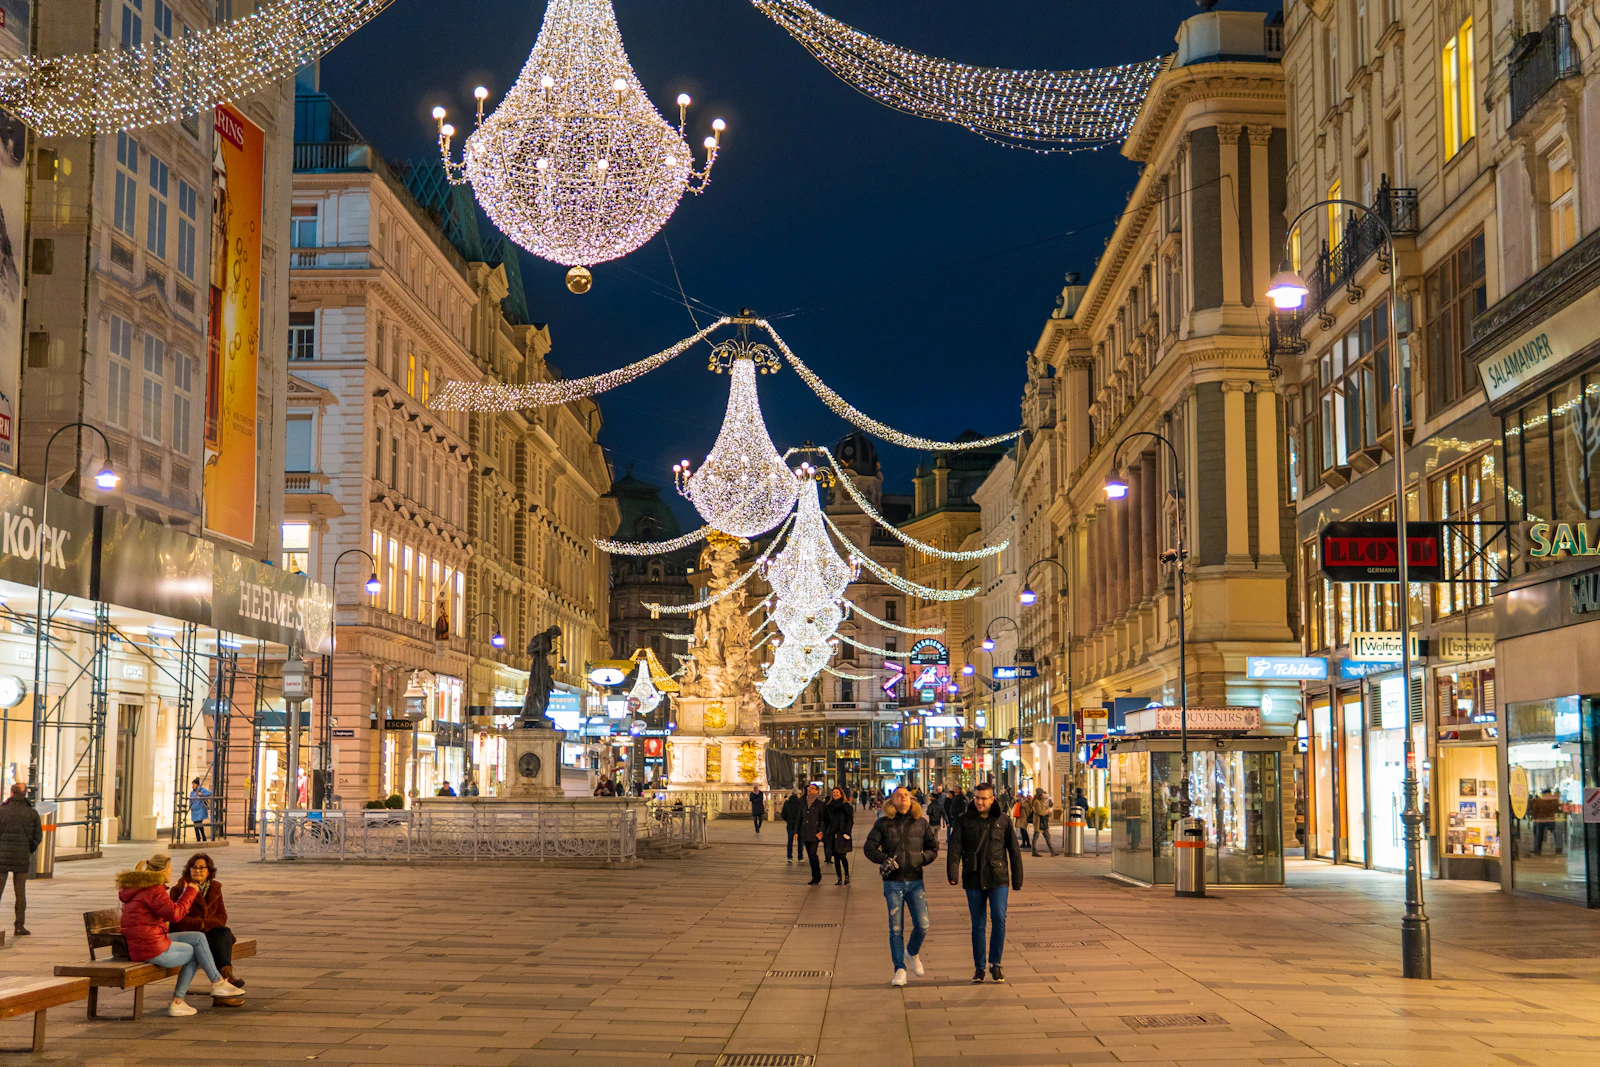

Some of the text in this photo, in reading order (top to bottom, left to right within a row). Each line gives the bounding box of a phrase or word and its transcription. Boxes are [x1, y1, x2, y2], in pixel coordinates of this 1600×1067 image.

[1488, 333, 1554, 390] SALAMANDER
[3, 505, 67, 570] KÖCK
[1530, 522, 1600, 557] SAL
[238, 580, 304, 631] HERMÈS
[997, 668, 1032, 677] Berlitz
[1273, 663, 1323, 676] Tchibo
